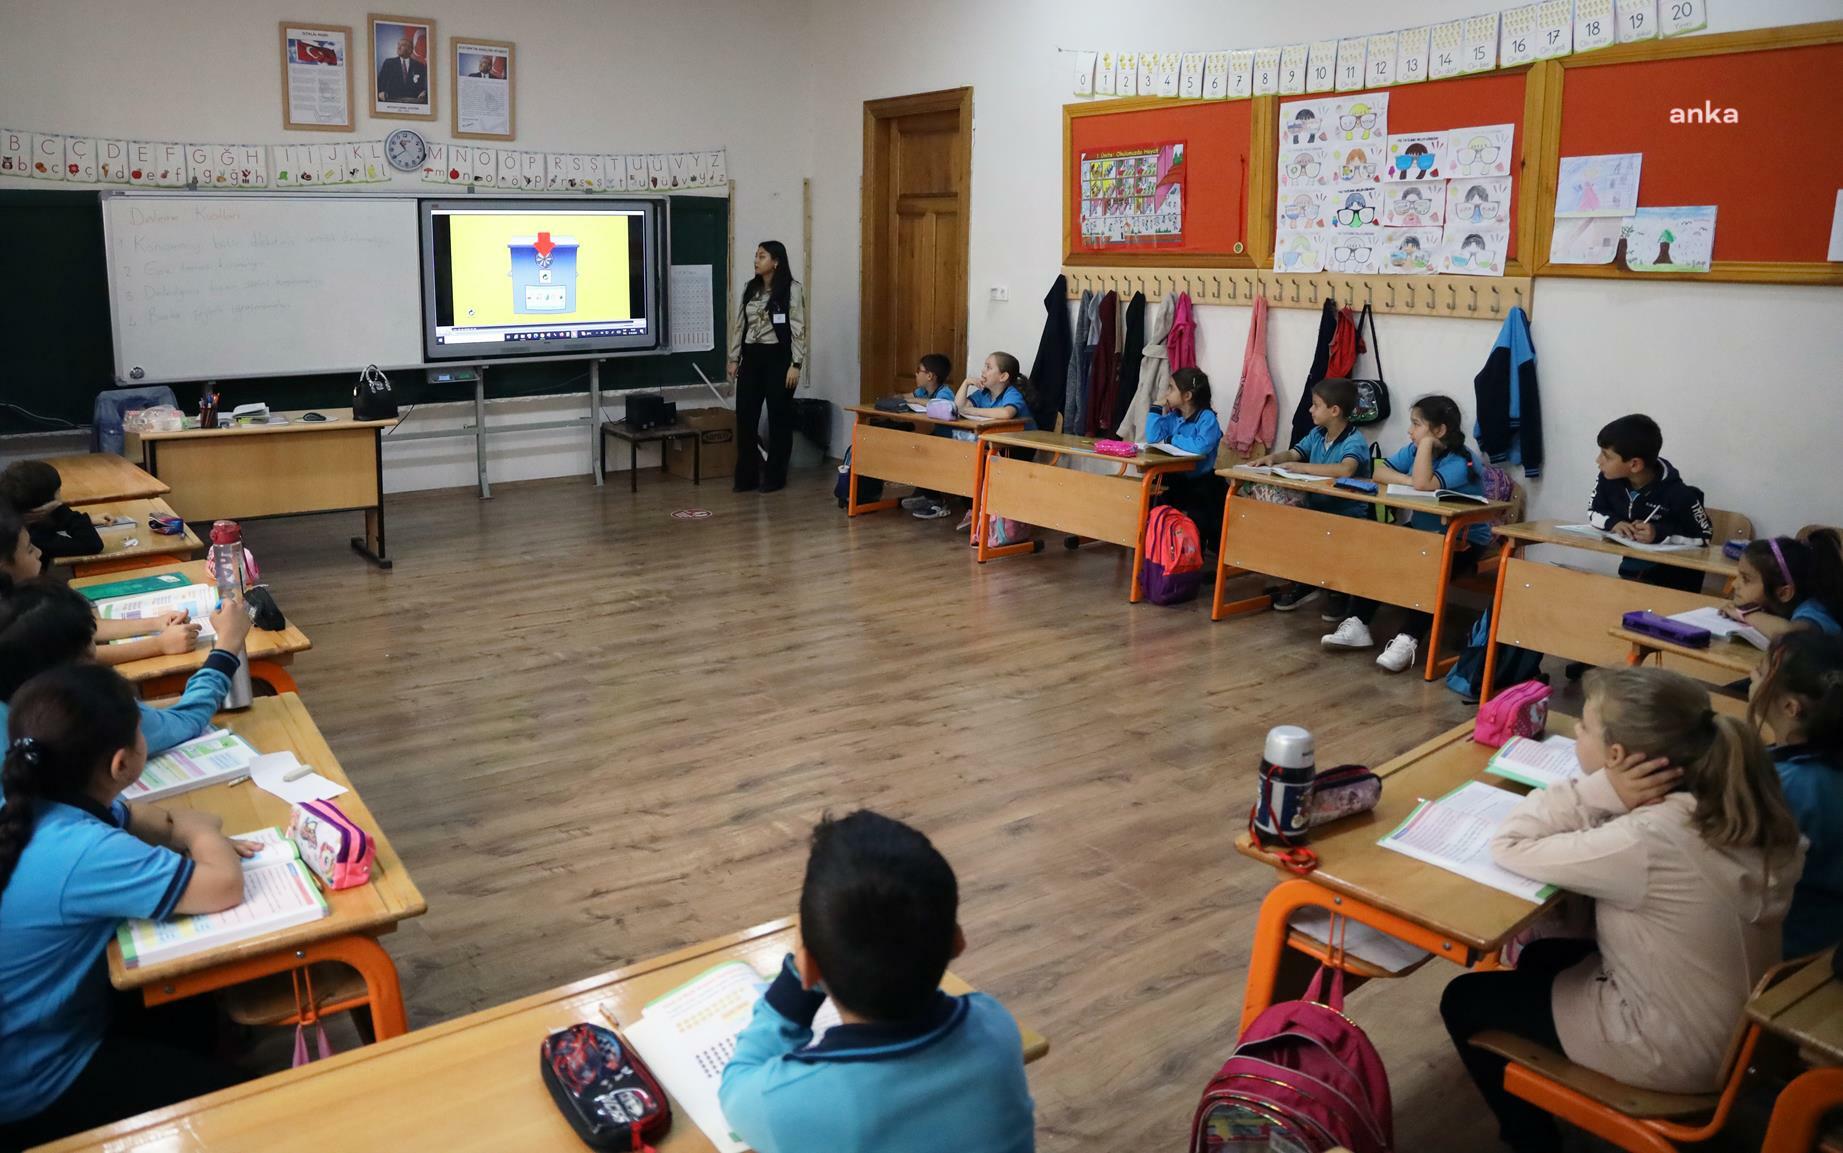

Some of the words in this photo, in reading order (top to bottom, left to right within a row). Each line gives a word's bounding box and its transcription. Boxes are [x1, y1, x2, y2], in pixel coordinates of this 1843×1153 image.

[1315, 67, 1326, 79] 10
[1346, 66, 1355, 78] 11
[1376, 61, 1387, 74] 12
[1406, 58, 1418, 72] 13
[1440, 52, 1452, 66] 14
[1474, 45, 1486, 60] 15
[1512, 38, 1526, 53] 16
[1547, 30, 1560, 45] 17
[1586, 21, 1600, 36] 18
[1629, 13, 1644, 29] 19
[1672, 2, 1692, 20] 20
[10, 135, 20, 151] B
[41, 139, 55, 155] C
[73, 141, 86, 159] Ç
[108, 143, 120, 158] D
[138, 146, 148, 162] E
[166, 146, 175, 164] F
[193, 149, 206, 164] G
[221, 148, 234, 165] Ğ
[246, 150, 258, 164] H
[329, 146, 336, 160] J
[353, 146, 362, 159] K
[372, 145, 380, 158] L
[428, 146, 442, 160] M
[456, 150, 466, 162] N
[479, 152, 490, 165] O
[529, 157, 536, 169] P
[555, 157, 562, 169] R
[573, 158, 580, 170] S
[611, 159, 618, 171] T
[633, 158, 642, 170] U
[675, 158, 682, 168] V
[693, 156, 700, 166] Y
[712, 154, 719, 167] Z
